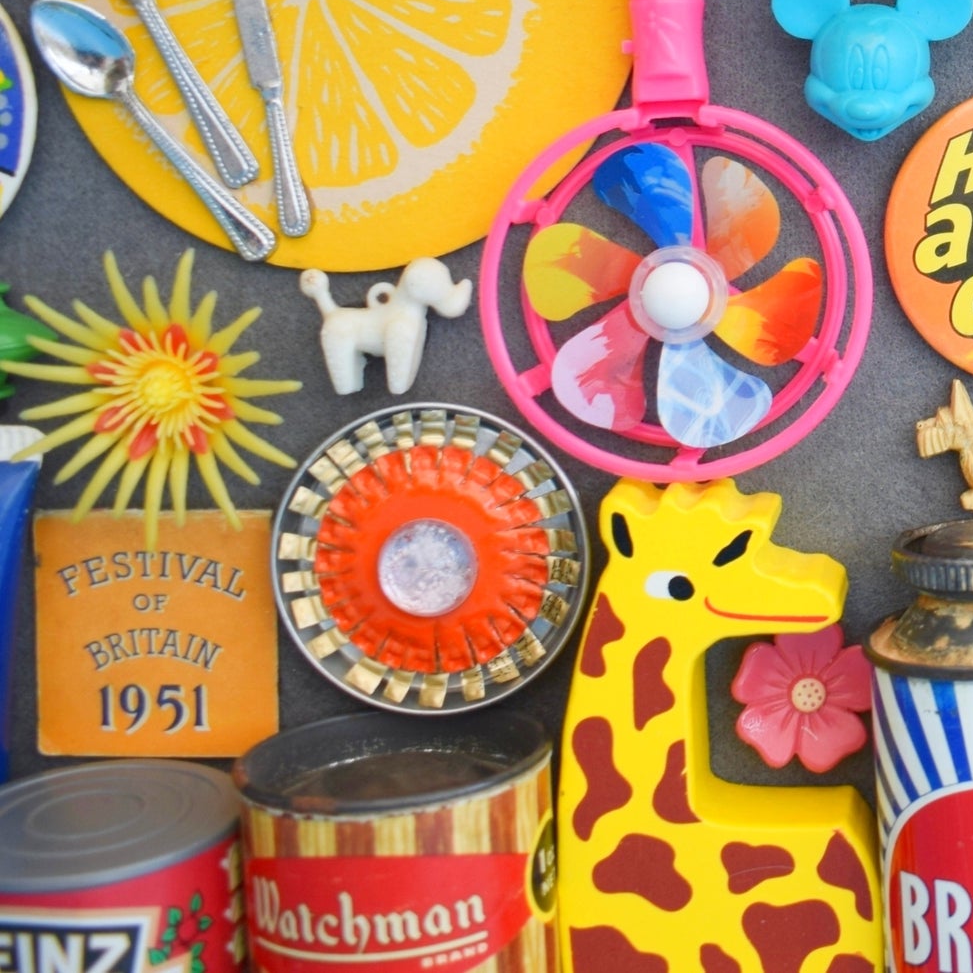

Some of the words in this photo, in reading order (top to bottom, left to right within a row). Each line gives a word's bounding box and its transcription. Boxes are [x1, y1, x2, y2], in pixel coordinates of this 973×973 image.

[914, 203, 973, 275] a
[56, 549, 248, 600] FESTIVAL
[133, 594, 169, 612] OF
[84, 627, 222, 672] BRITAIN
[98, 683, 210, 734] 1951
[254, 875, 486, 953] Watchman
[421, 941, 489, 968] BRAND
